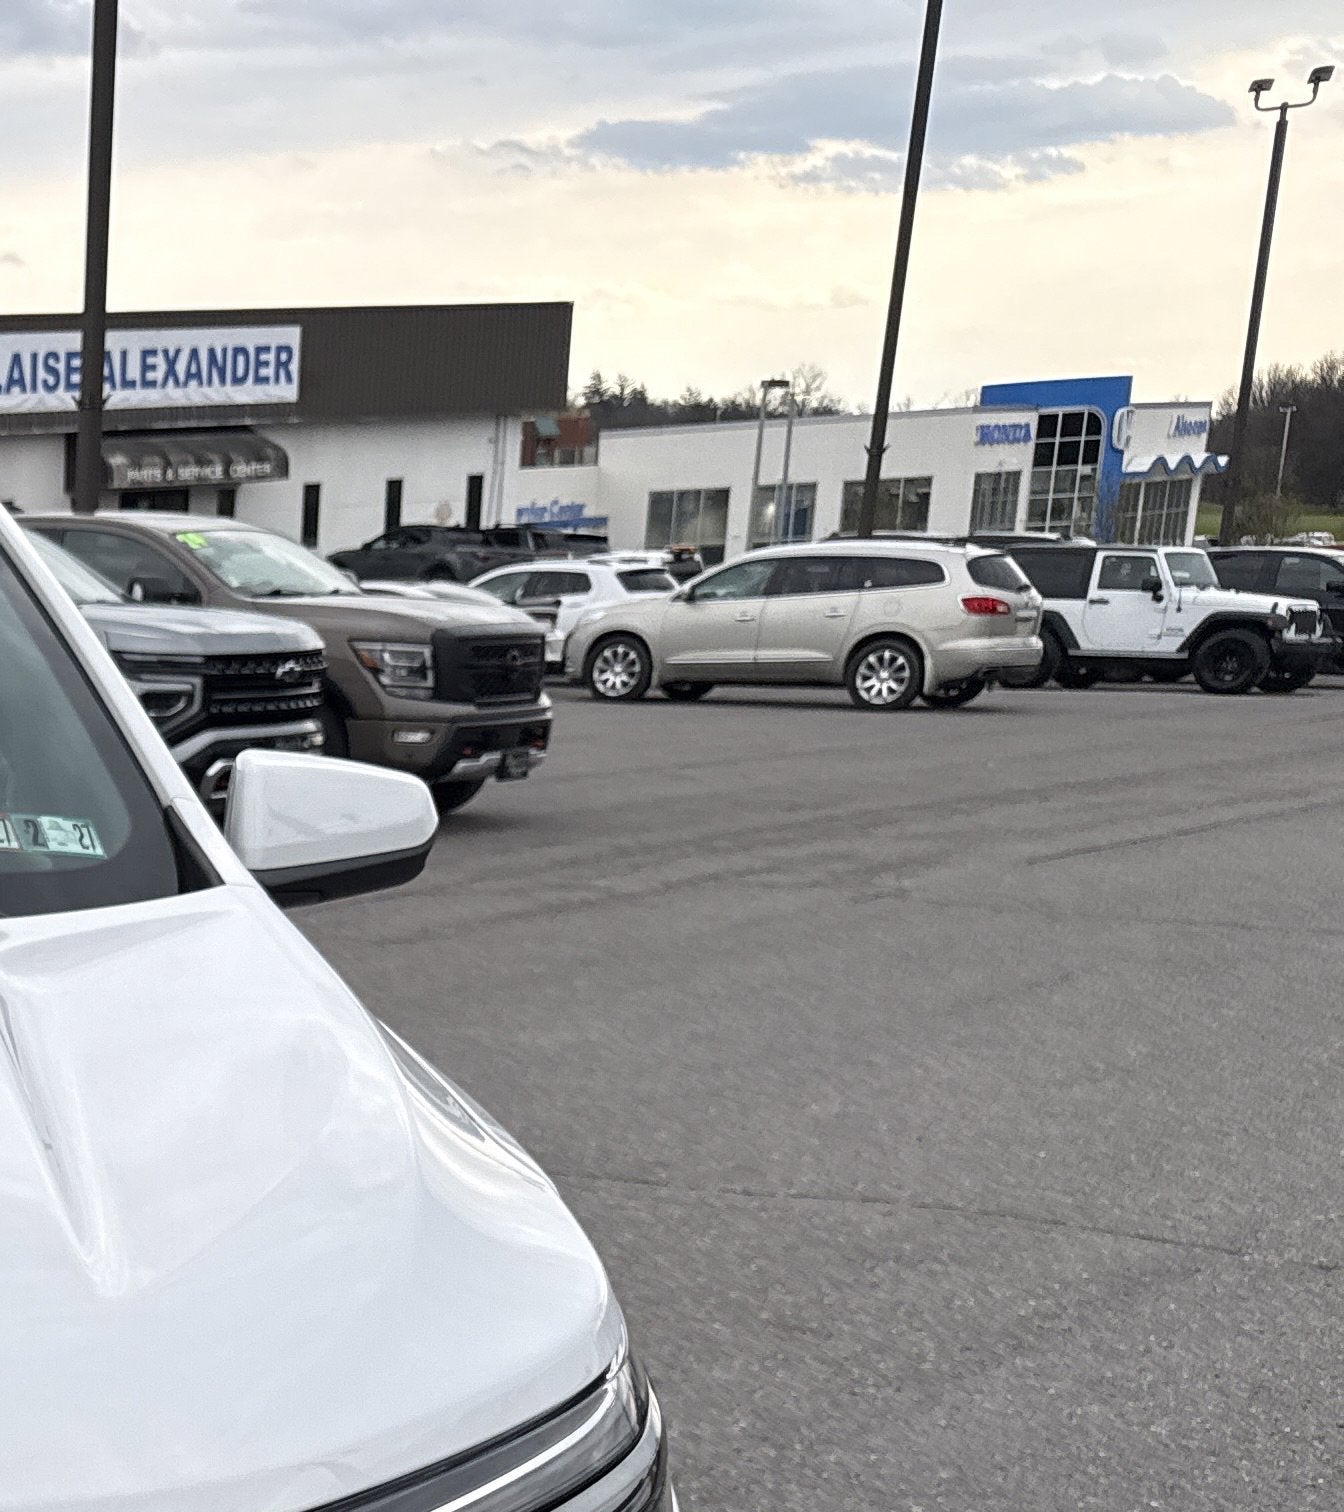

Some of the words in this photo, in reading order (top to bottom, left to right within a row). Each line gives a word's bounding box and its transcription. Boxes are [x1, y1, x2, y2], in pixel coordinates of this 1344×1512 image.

[103, 345, 293, 391] ALEXANDER
[178, 463, 224, 480] SERVICE
[230, 461, 271, 478] CENTER
[72, 823, 97, 853] 27
